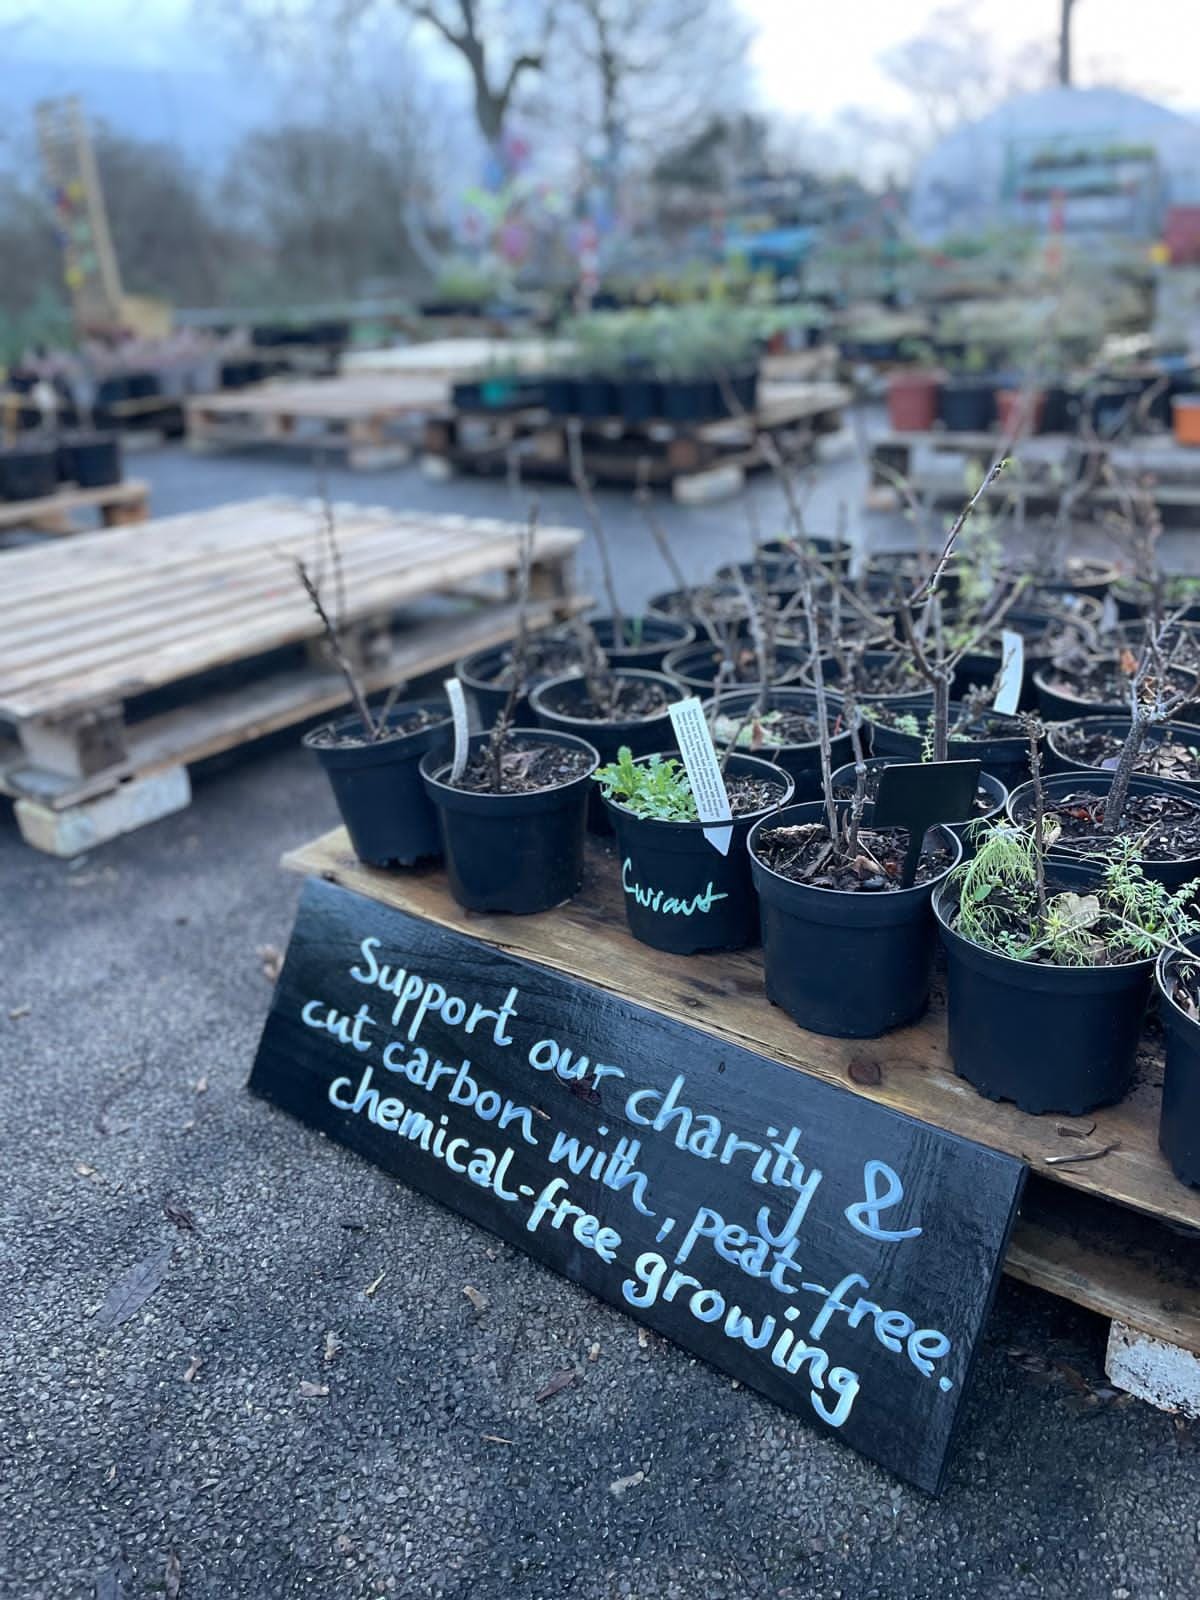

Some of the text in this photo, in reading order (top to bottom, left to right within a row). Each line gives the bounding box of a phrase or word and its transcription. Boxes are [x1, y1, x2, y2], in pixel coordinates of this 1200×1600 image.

[301, 1000, 376, 1051] cut
[382, 1041, 539, 1145] carbon
[350, 936, 923, 1248] Support our charity &
[328, 1065, 860, 1428] chemical-free growing
